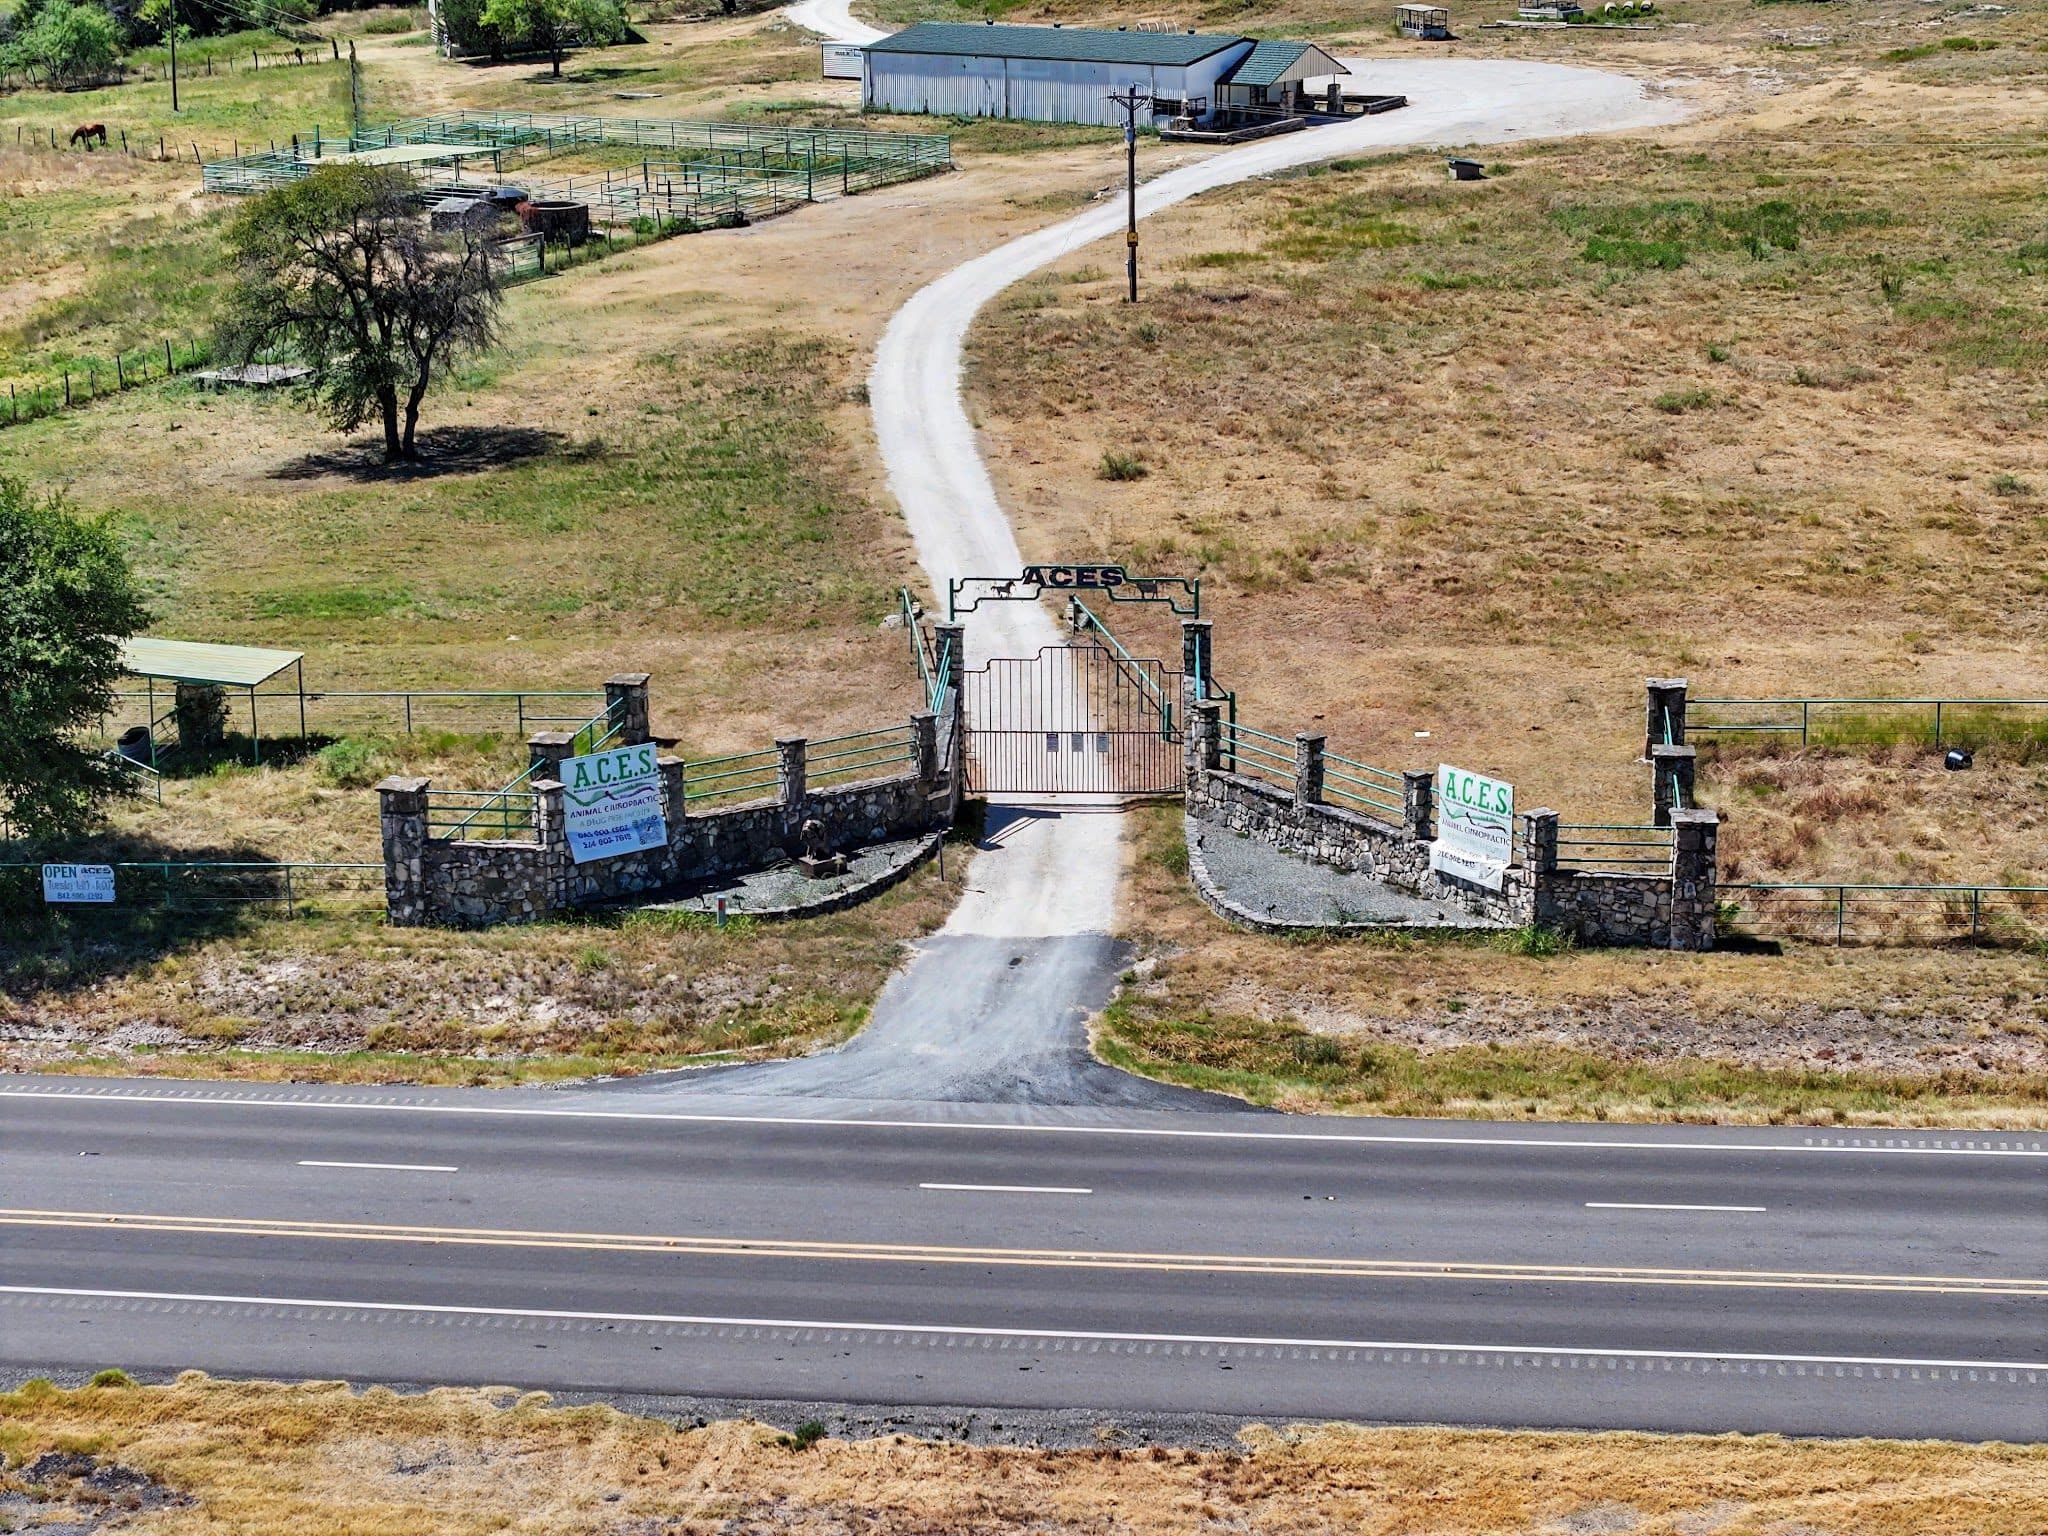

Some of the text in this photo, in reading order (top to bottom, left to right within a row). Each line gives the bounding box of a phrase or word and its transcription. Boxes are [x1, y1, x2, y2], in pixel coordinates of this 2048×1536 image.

[1023, 567, 1122, 586] ACES
[573, 750, 657, 788] A.C.E.S.
[1446, 771, 1512, 815] A.C.E.S.
[570, 808, 602, 819] ANIMAL
[44, 866, 77, 878] OPEN
